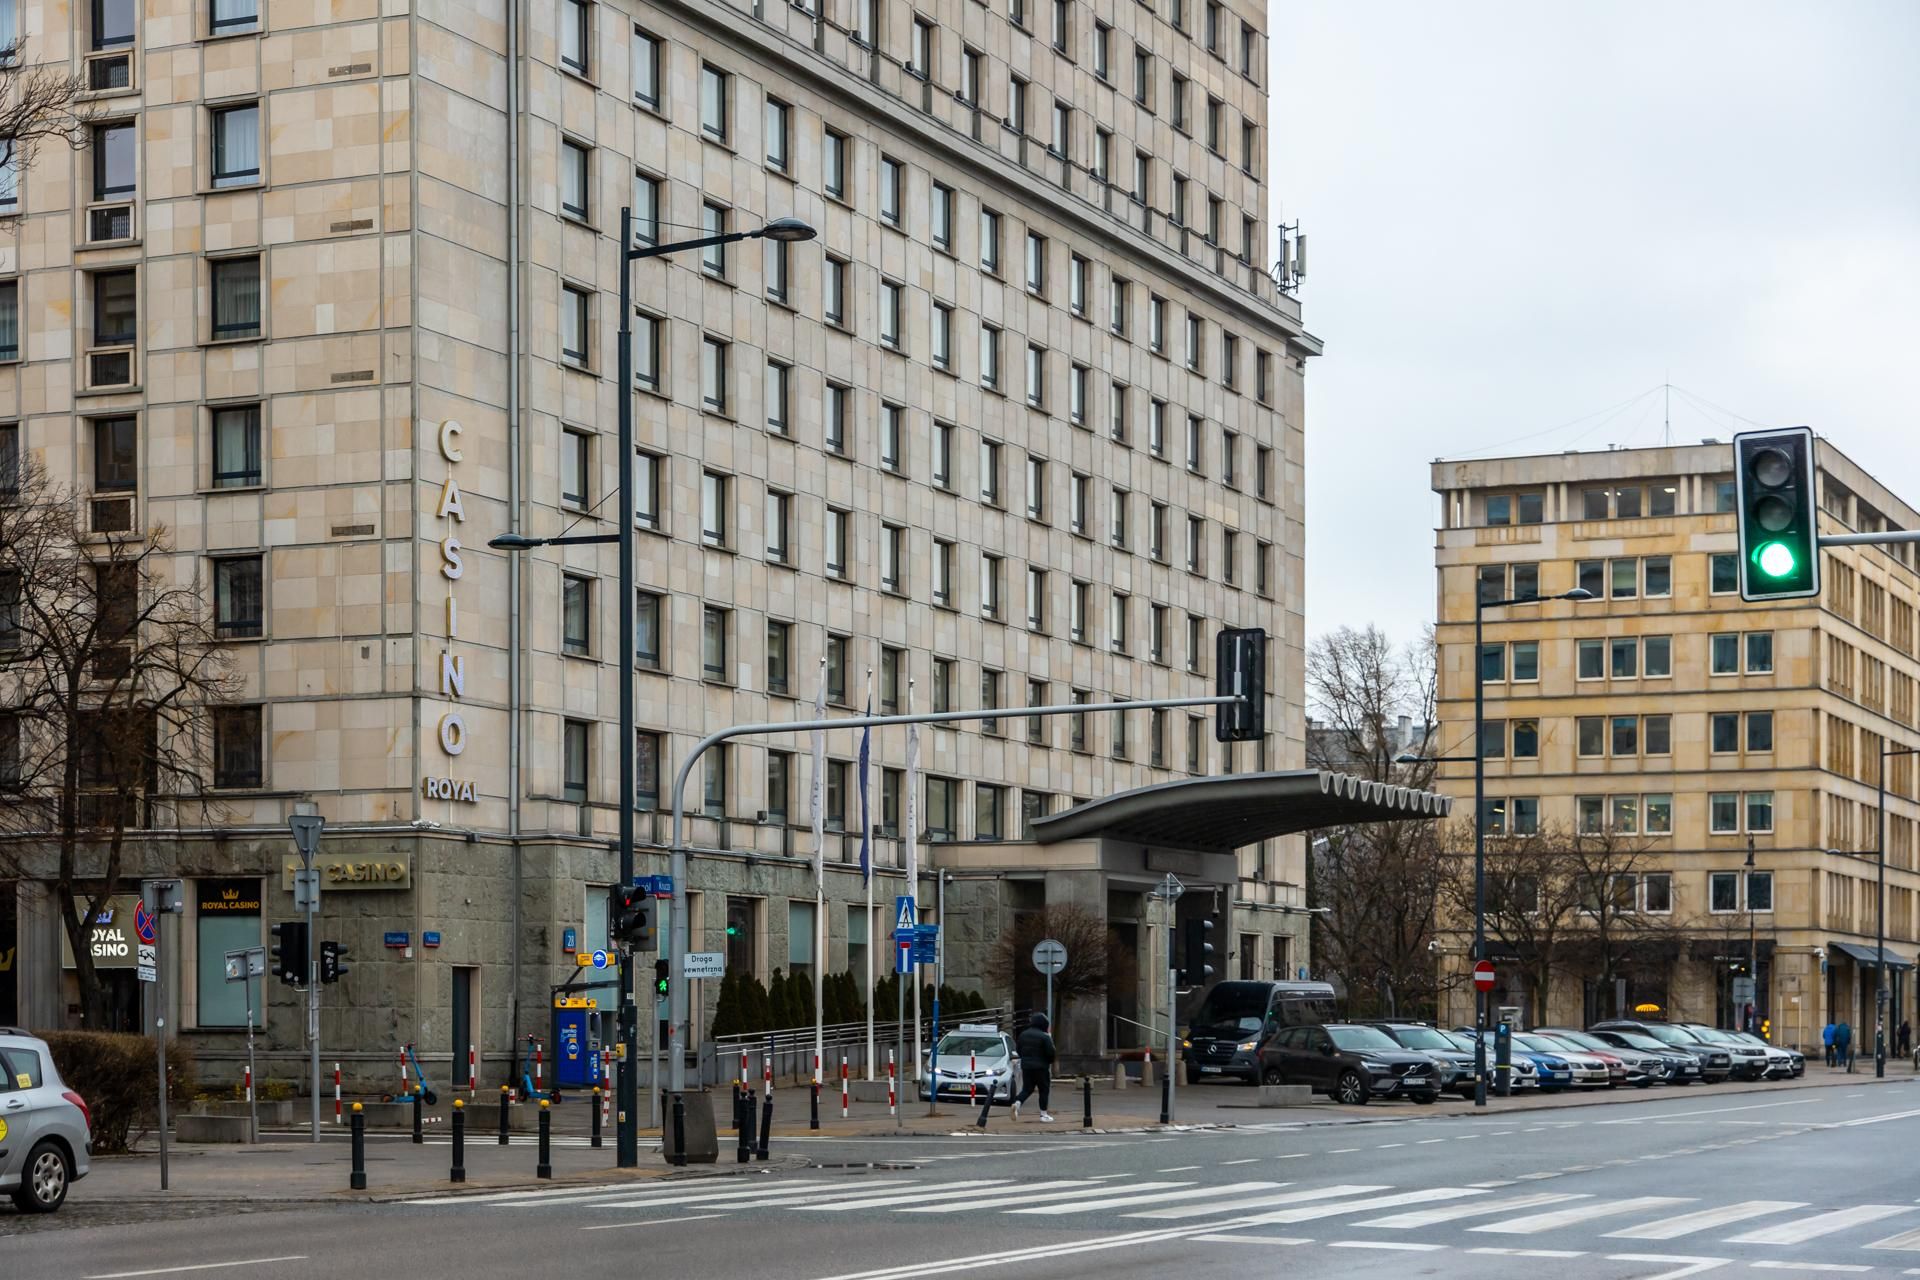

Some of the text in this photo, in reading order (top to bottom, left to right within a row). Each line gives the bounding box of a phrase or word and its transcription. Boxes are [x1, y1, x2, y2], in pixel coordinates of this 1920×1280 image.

[437, 419, 467, 756] CASINO
[424, 777, 480, 802] ROYAL
[326, 863, 404, 881] CASINO
[202, 901, 260, 909] ROYAL CASINO
[91, 928, 125, 942] OYAL
[567, 935, 575, 947] 28
[90, 943, 129, 957] SINO
[691, 955, 713, 964] Droga
[1500, 1024, 1506, 1033] P
